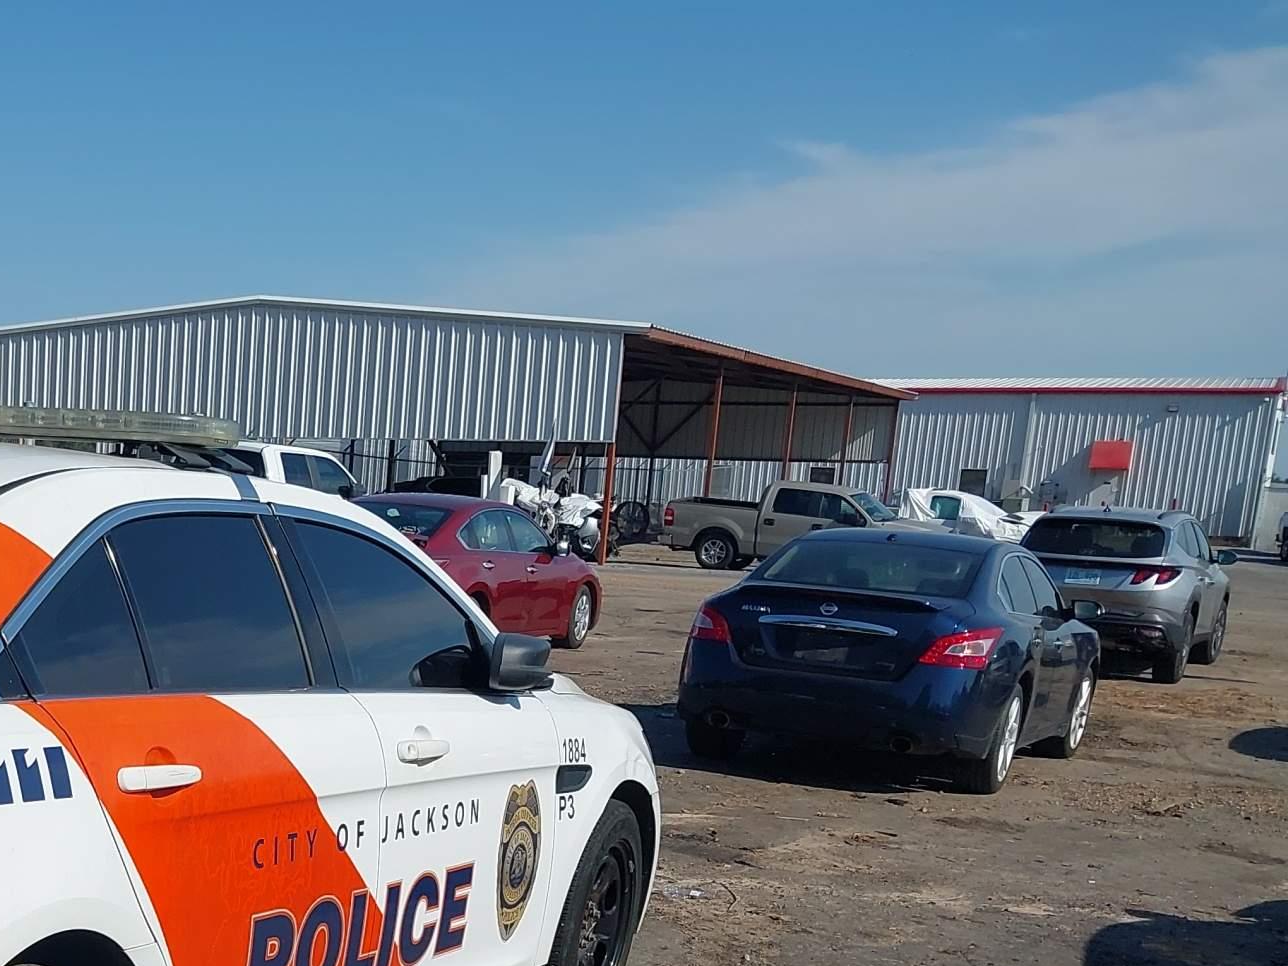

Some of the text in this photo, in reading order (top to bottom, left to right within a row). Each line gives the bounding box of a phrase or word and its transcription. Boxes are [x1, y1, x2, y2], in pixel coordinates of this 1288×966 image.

[562, 738, 587, 763] 1884
[558, 794, 576, 821] P3
[253, 828, 319, 870] CITY
[336, 819, 366, 853] OF
[381, 797, 482, 845] JACKSON
